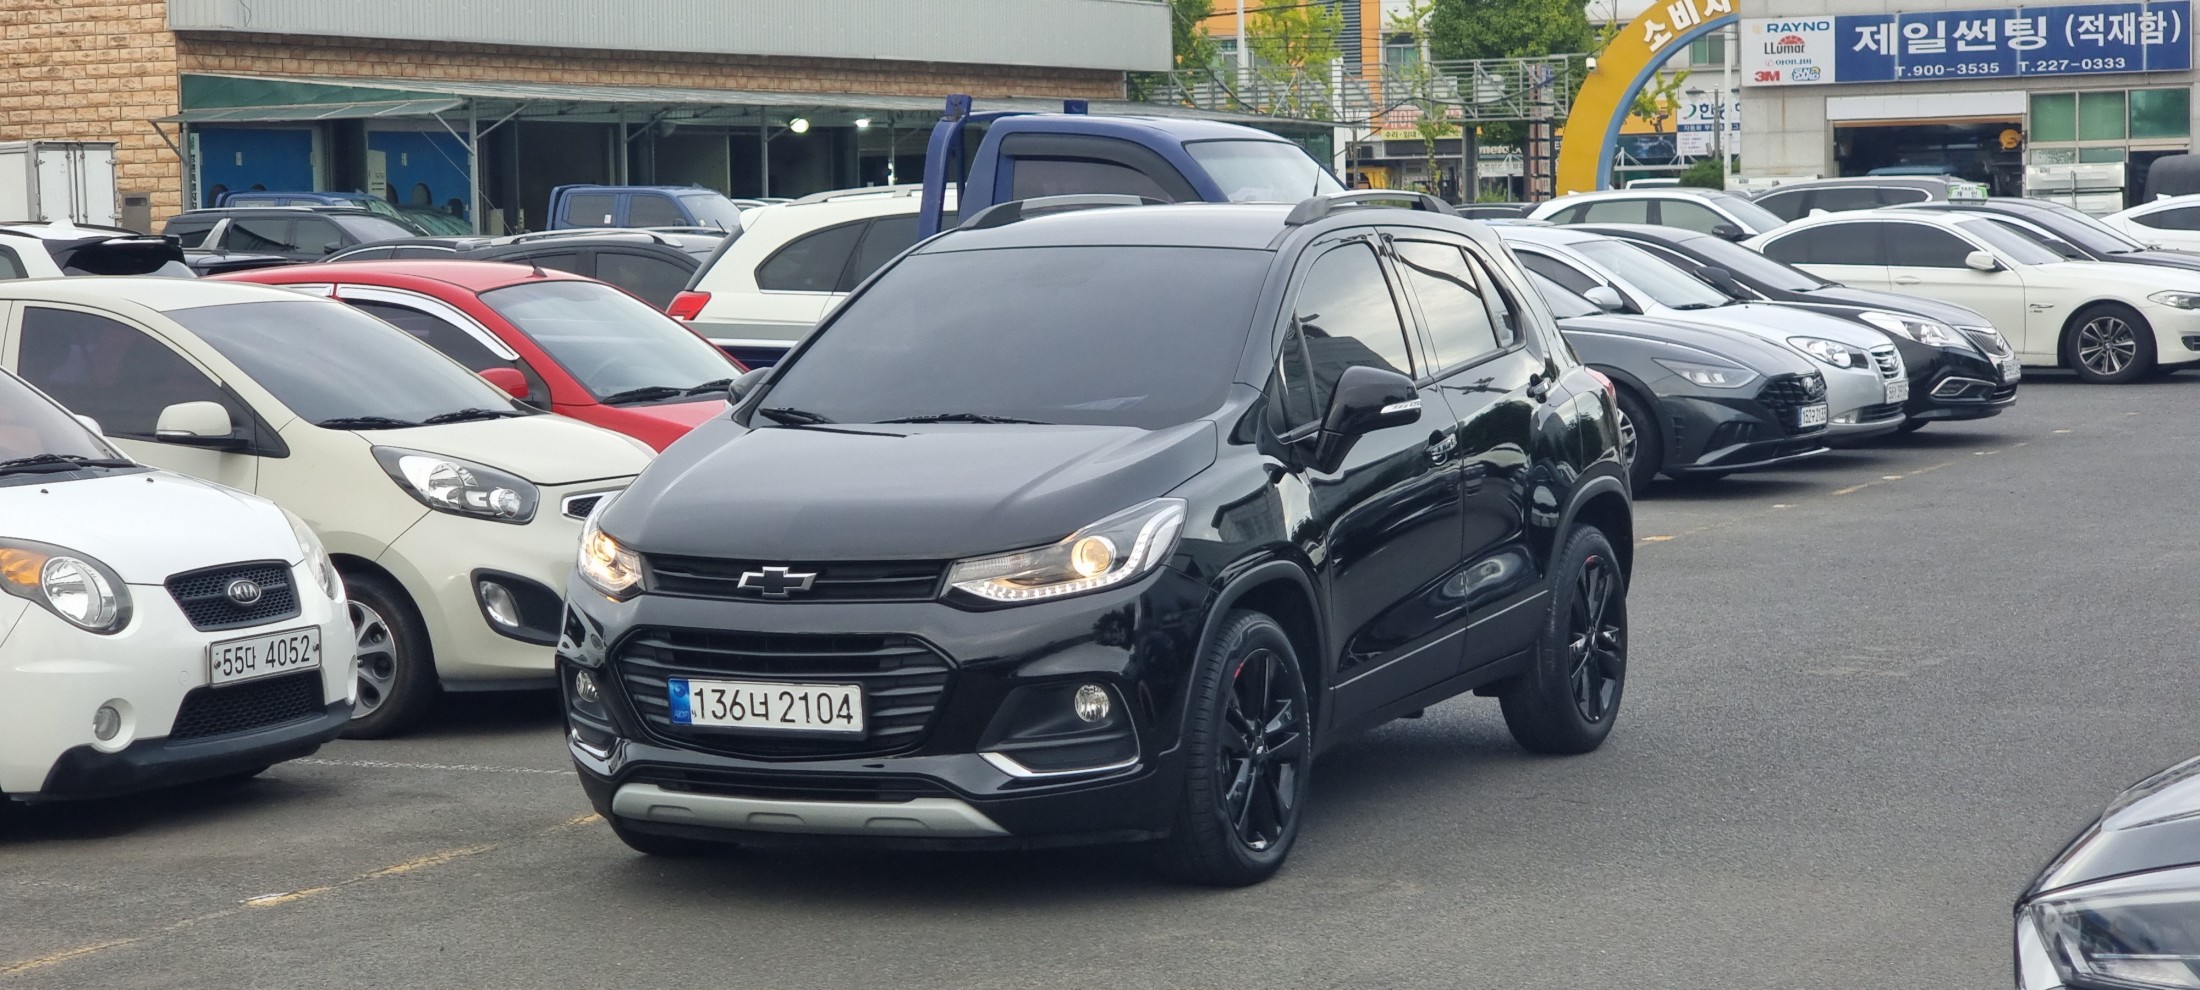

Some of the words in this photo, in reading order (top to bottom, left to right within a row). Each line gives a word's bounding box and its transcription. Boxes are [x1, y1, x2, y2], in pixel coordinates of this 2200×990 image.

[1766, 21, 1830, 33] RAYNO
[1853, 16, 2047, 55] 제일썬팅
[2065, 9, 2181, 47] (적재함)
[1764, 42, 1806, 54] LLumar
[1775, 58, 1812, 66] 아이나비
[1895, 62, 2000, 77] T.900-3535
[2019, 57, 2126, 72] T.227-0333
[1754, 70, 1781, 82] 3M
[233, 584, 259, 600] KIA
[223, 646, 256, 677] 55다
[265, 635, 310, 668] 4052
[694, 687, 769, 721] 136너
[779, 690, 854, 725] 2104
